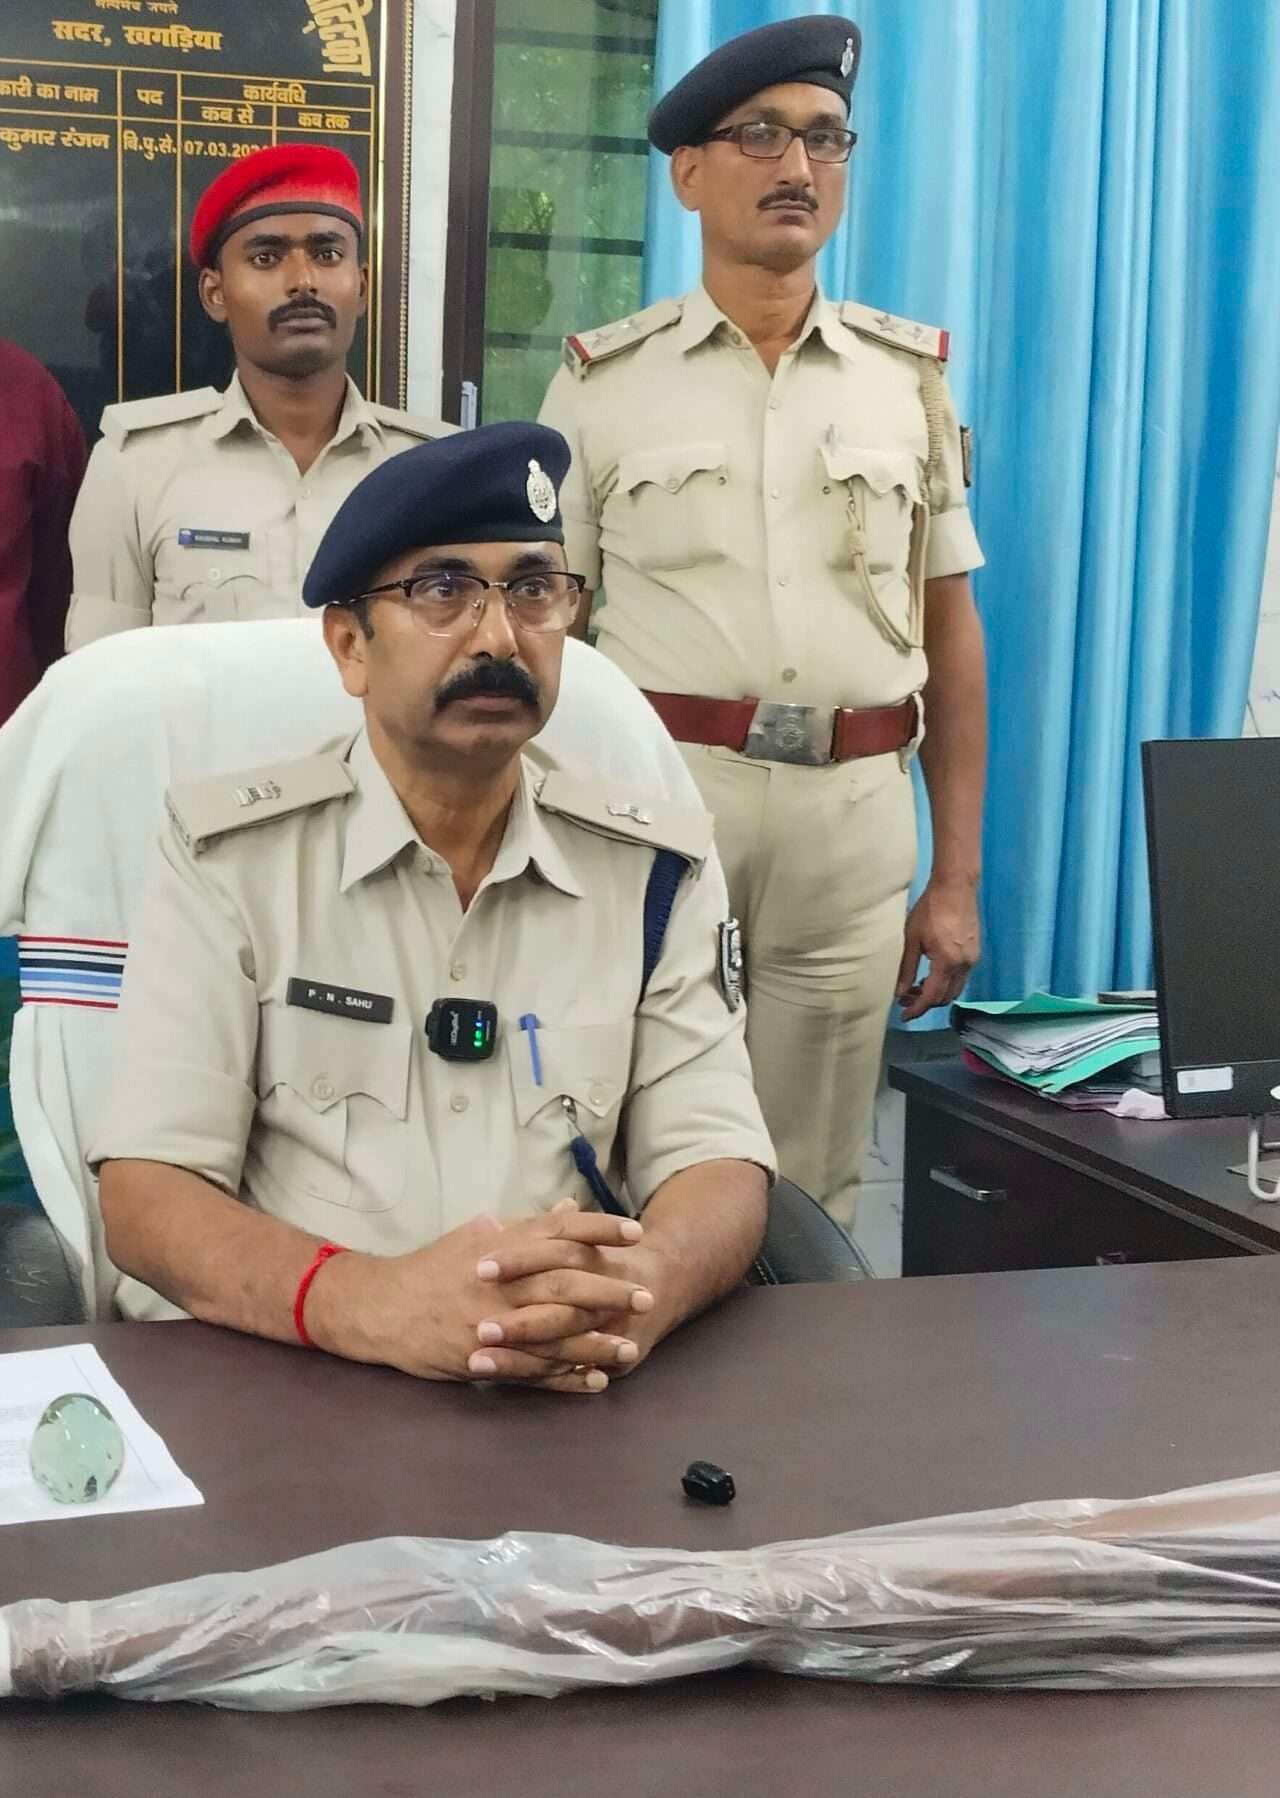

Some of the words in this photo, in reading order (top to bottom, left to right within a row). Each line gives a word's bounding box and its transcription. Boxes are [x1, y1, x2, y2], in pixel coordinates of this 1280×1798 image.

[52, 20, 112, 47] सदर,
[122, 24, 223, 52] खगड़िया
[36, 83, 60, 100] का
[64, 86, 99, 103] नाम
[136, 88, 164, 105] पद
[200, 106, 233, 122] कब
[237, 103, 254, 124] से
[325, 113, 351, 129] तक
[60, 126, 111, 149] रंजन
[184, 140, 269, 158] 07.03.20
[345, 996, 372, 1009] SAHU
